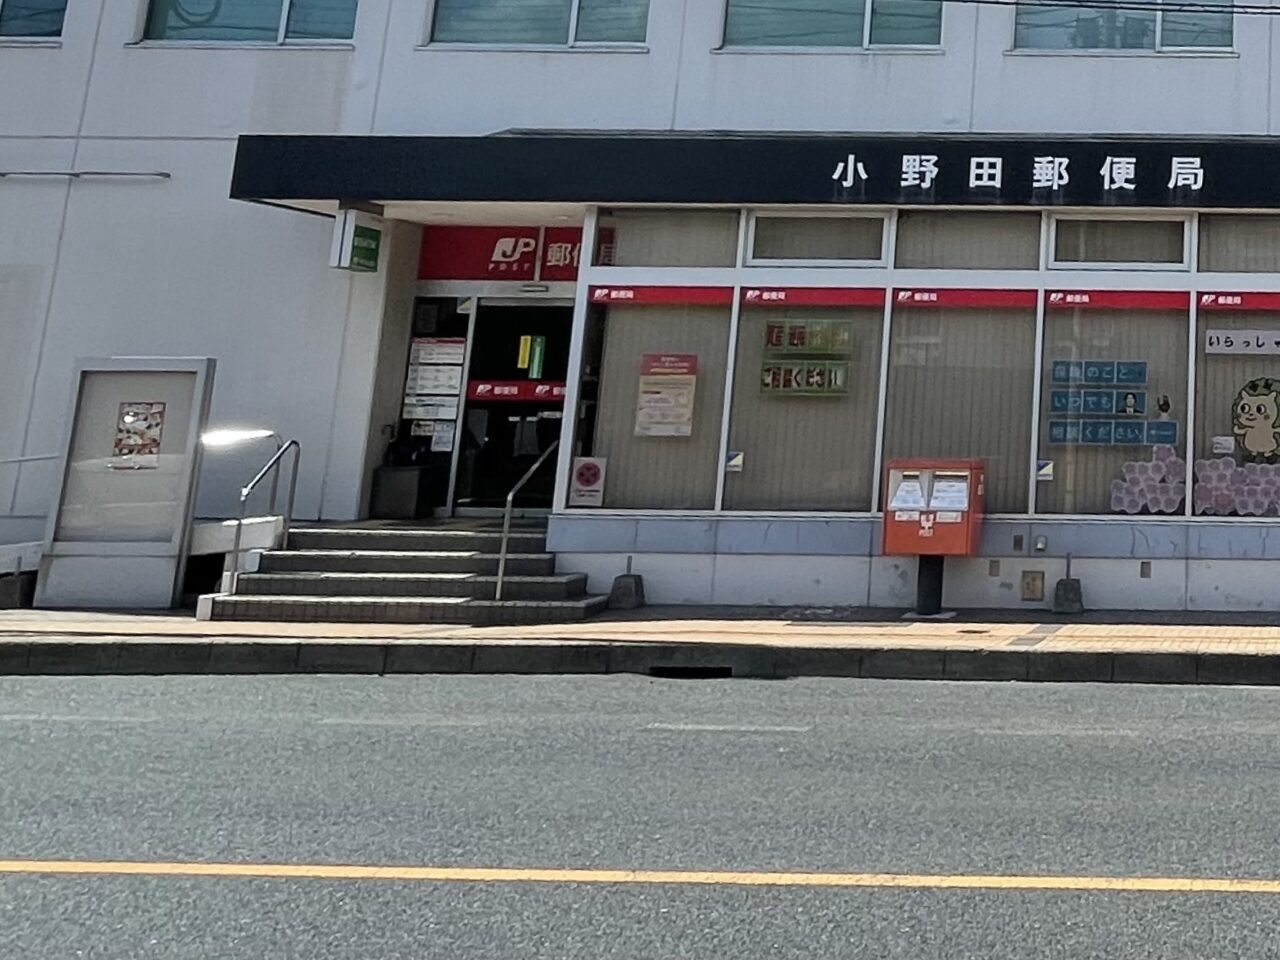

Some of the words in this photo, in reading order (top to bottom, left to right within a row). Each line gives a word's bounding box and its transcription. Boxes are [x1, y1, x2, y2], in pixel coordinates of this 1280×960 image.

[832, 154, 1204, 190] 小野田郵便局
